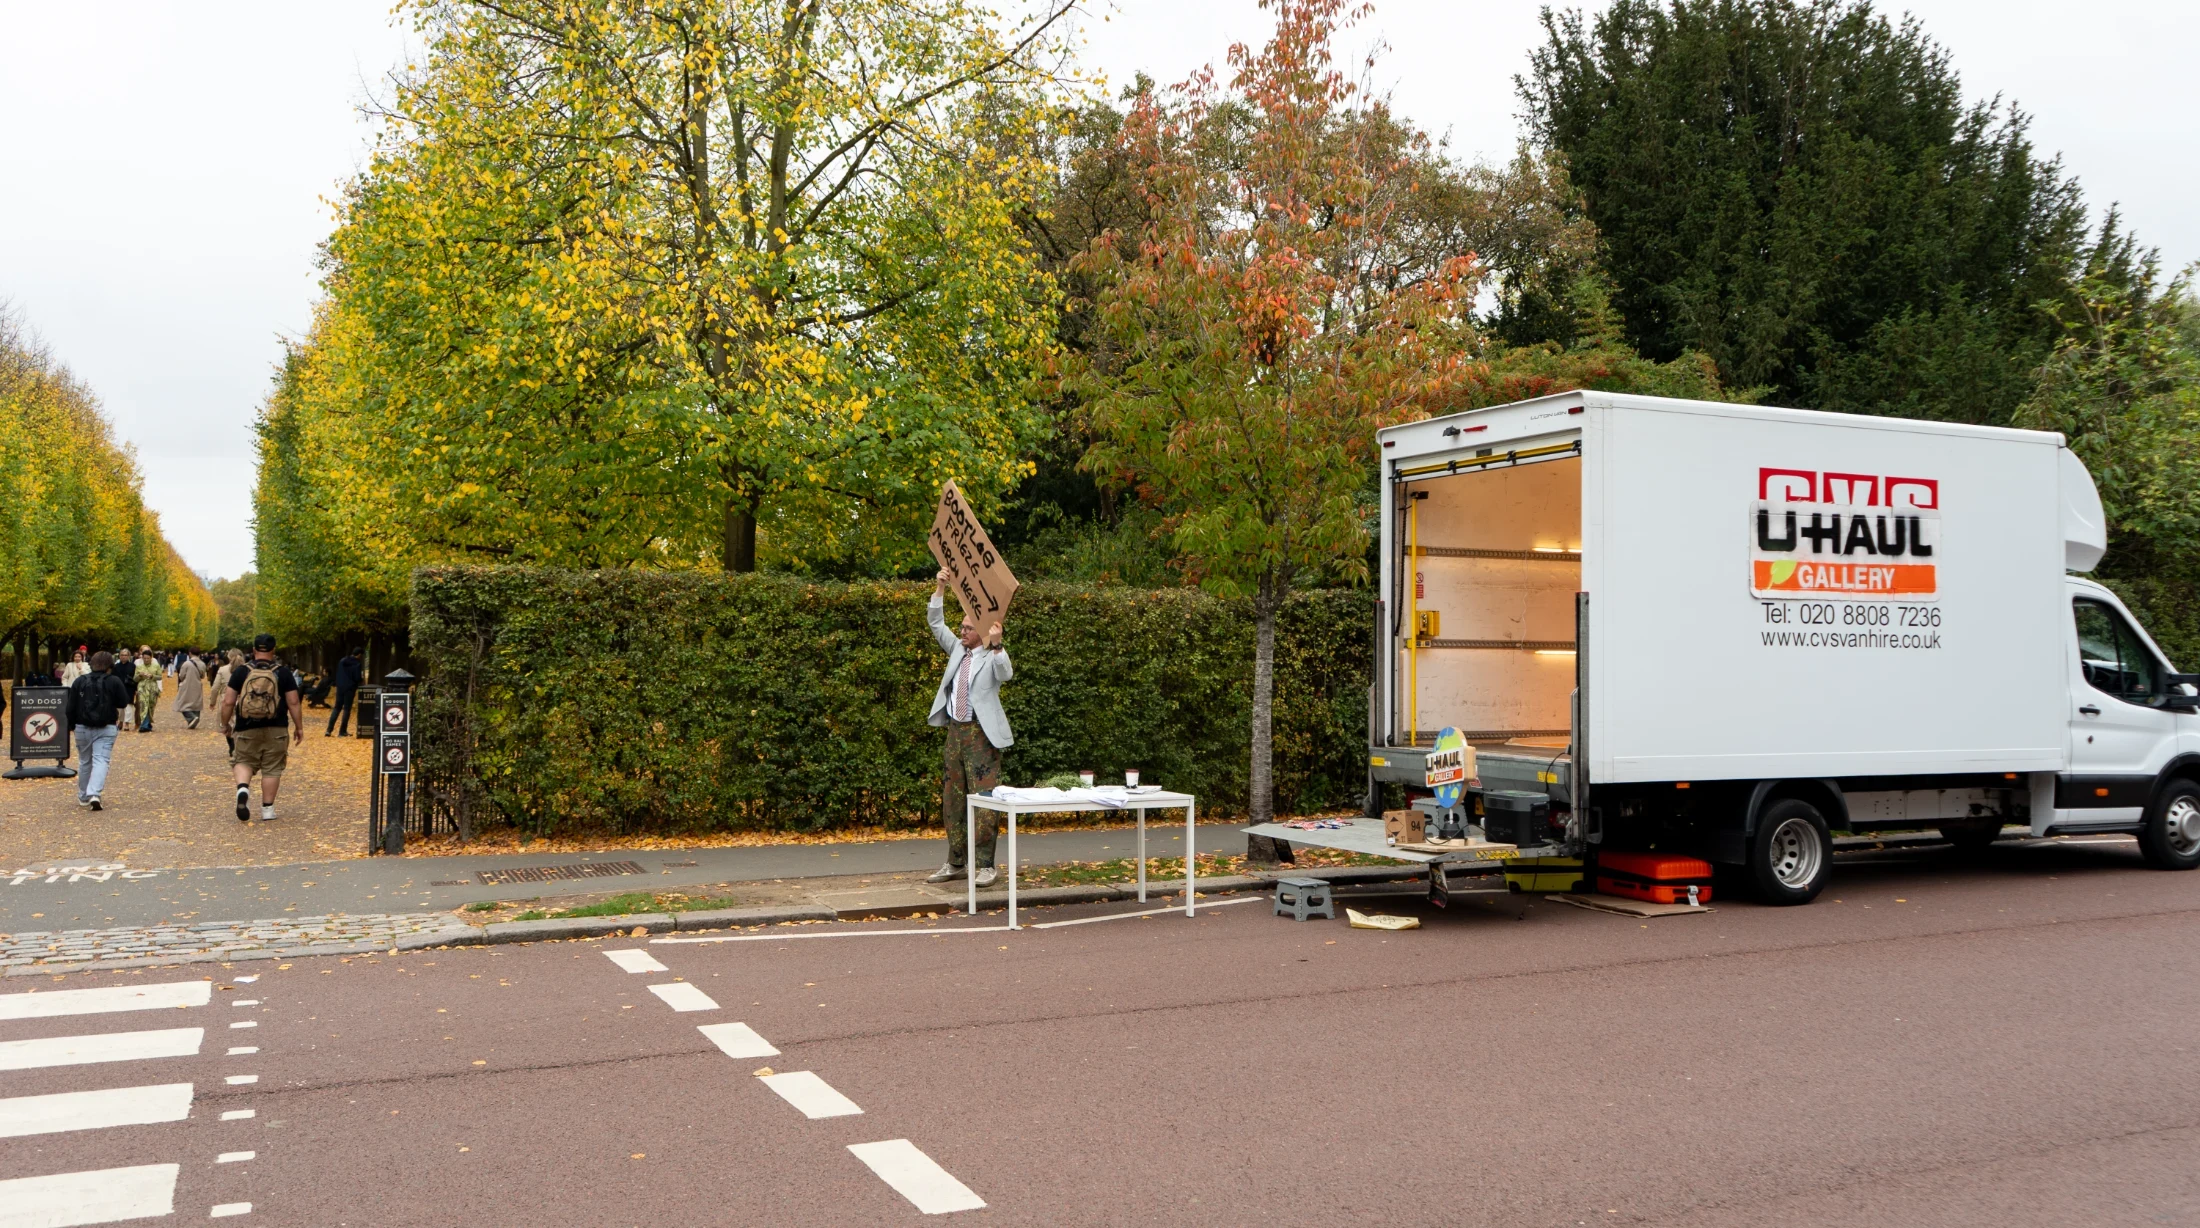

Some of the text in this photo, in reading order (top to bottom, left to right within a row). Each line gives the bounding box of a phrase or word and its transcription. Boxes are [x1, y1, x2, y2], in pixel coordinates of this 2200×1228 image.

[1757, 509, 1933, 557] U-HAUL
[945, 515, 980, 578] FRIEZE
[1797, 565, 1895, 589] GALLERY
[961, 576, 982, 621] HERE
[1761, 603, 1941, 627] Tel: 020 8808 7236
[1761, 629, 1941, 649] www.cvsvanhire.co.uk
[1425, 750, 1462, 771] U-HAUL
[1435, 770, 1455, 782] GALLERY
[1410, 820, 1421, 831] 94
